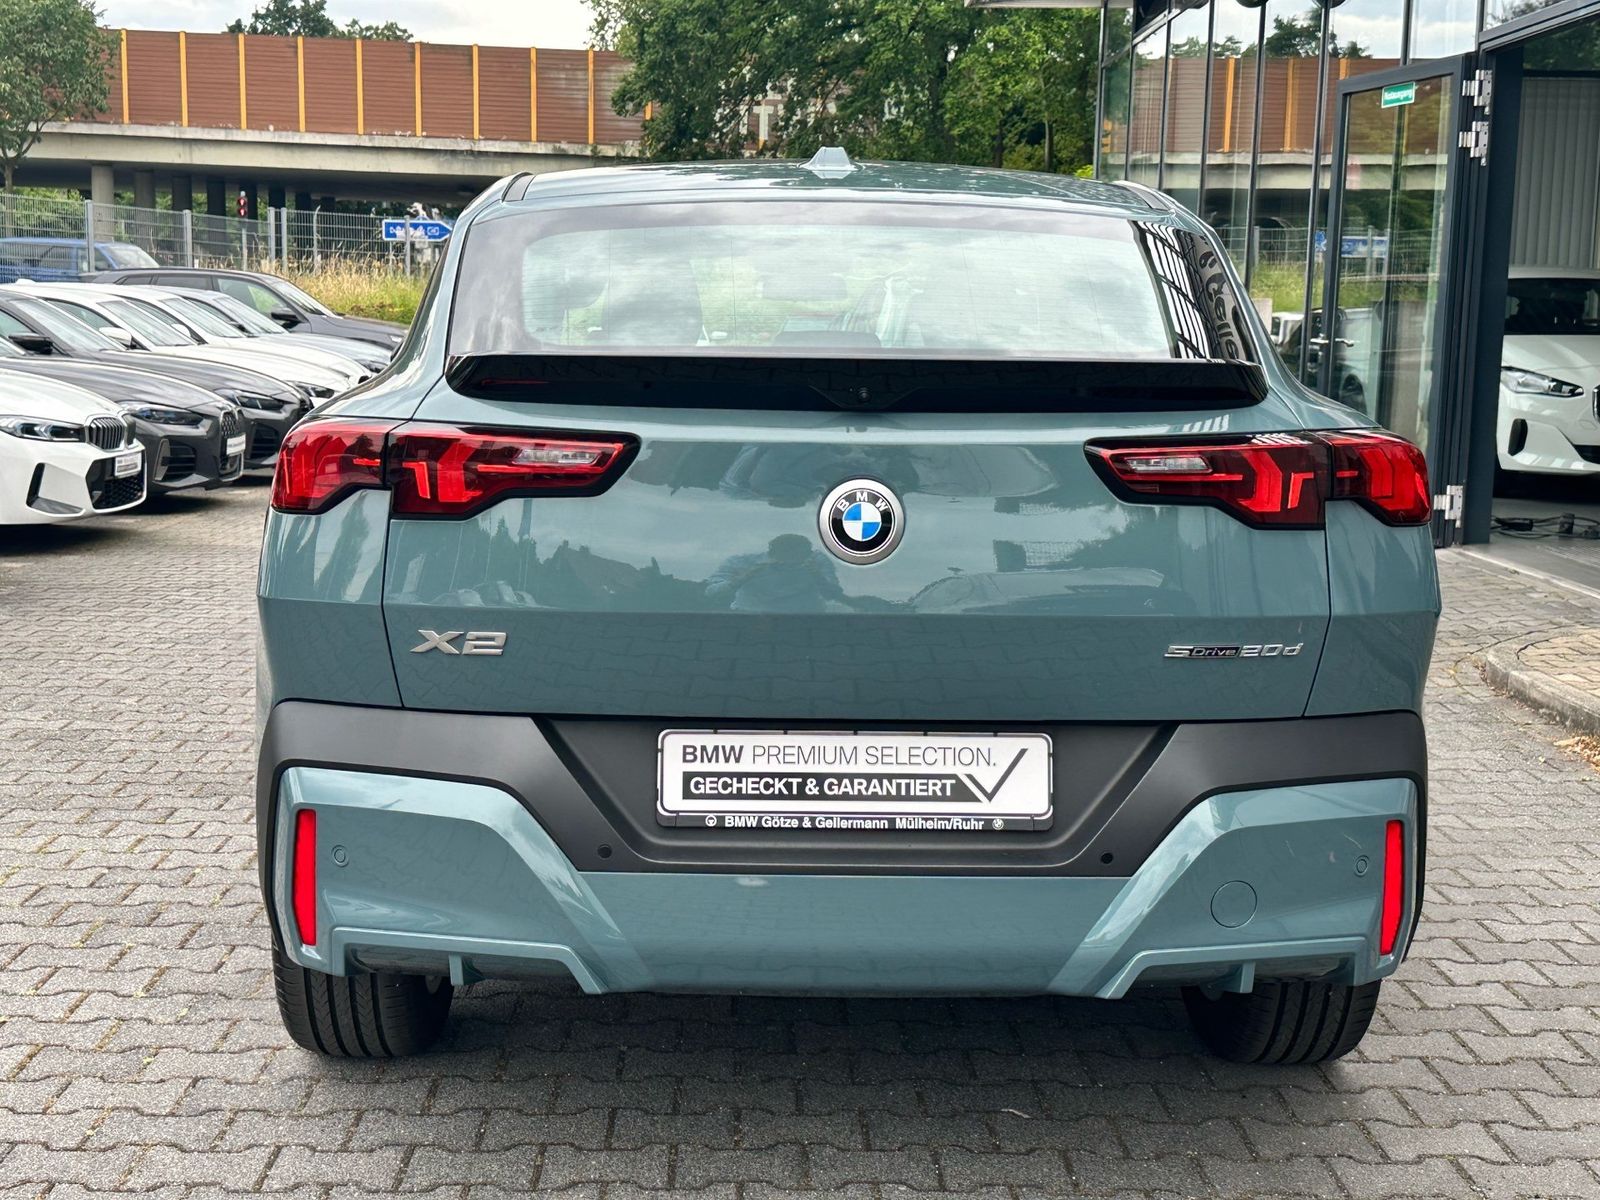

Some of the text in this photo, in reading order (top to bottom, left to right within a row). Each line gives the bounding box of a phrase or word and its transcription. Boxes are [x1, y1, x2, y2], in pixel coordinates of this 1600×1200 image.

[836, 491, 888, 511] BMW
[409, 629, 506, 655] X2
[682, 745, 997, 767] BMW PREMIUM SELECTION.
[690, 776, 956, 796] GECHECKT & GARANTIERT
[724, 816, 758, 827] BMW
[762, 816, 798, 828] Götze
[802, 818, 811, 828] &
